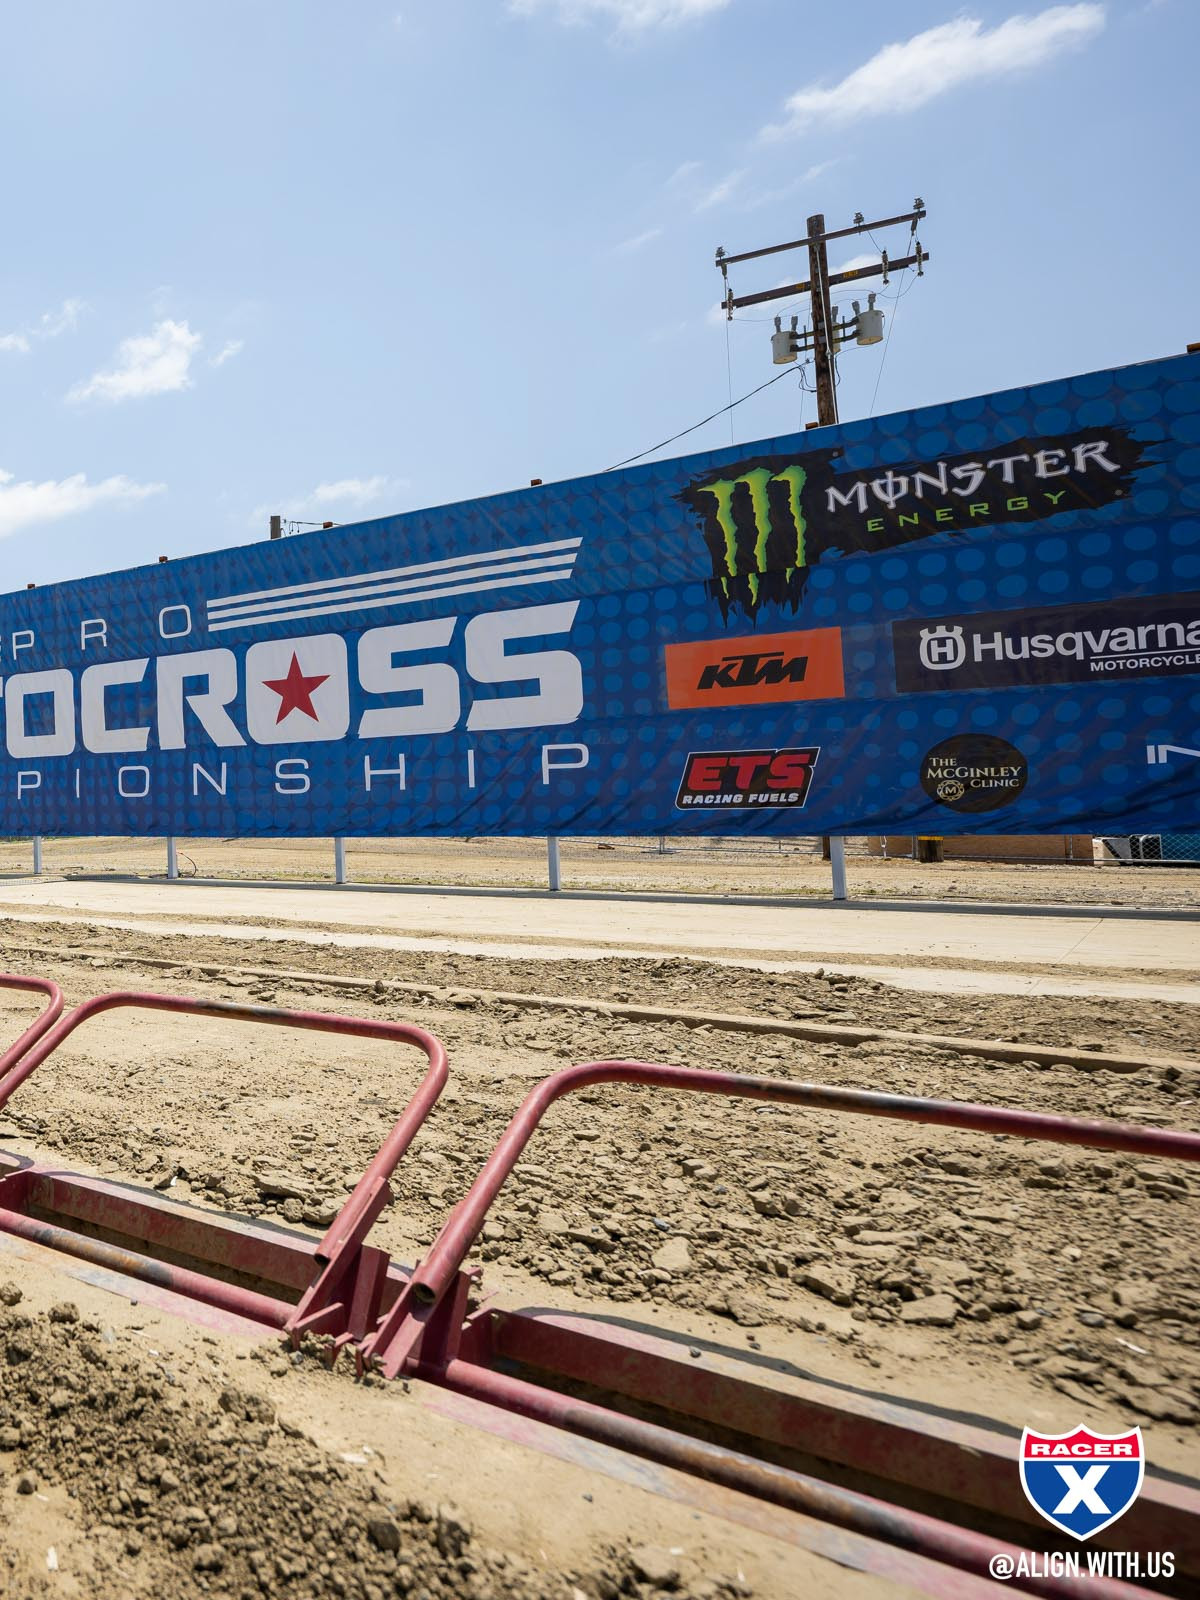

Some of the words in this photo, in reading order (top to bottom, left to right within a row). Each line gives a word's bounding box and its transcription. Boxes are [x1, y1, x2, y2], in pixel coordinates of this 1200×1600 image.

[825, 440, 1121, 513] MONSTER
[867, 490, 1066, 532] ENERGY
[12, 604, 191, 660] PRO
[697, 652, 808, 690] KTM
[688, 754, 810, 791] ETS
[929, 757, 957, 767] THE
[682, 794, 743, 804] RACING
[748, 792, 800, 804] FUELS
[970, 778, 1020, 788] CLINIC
